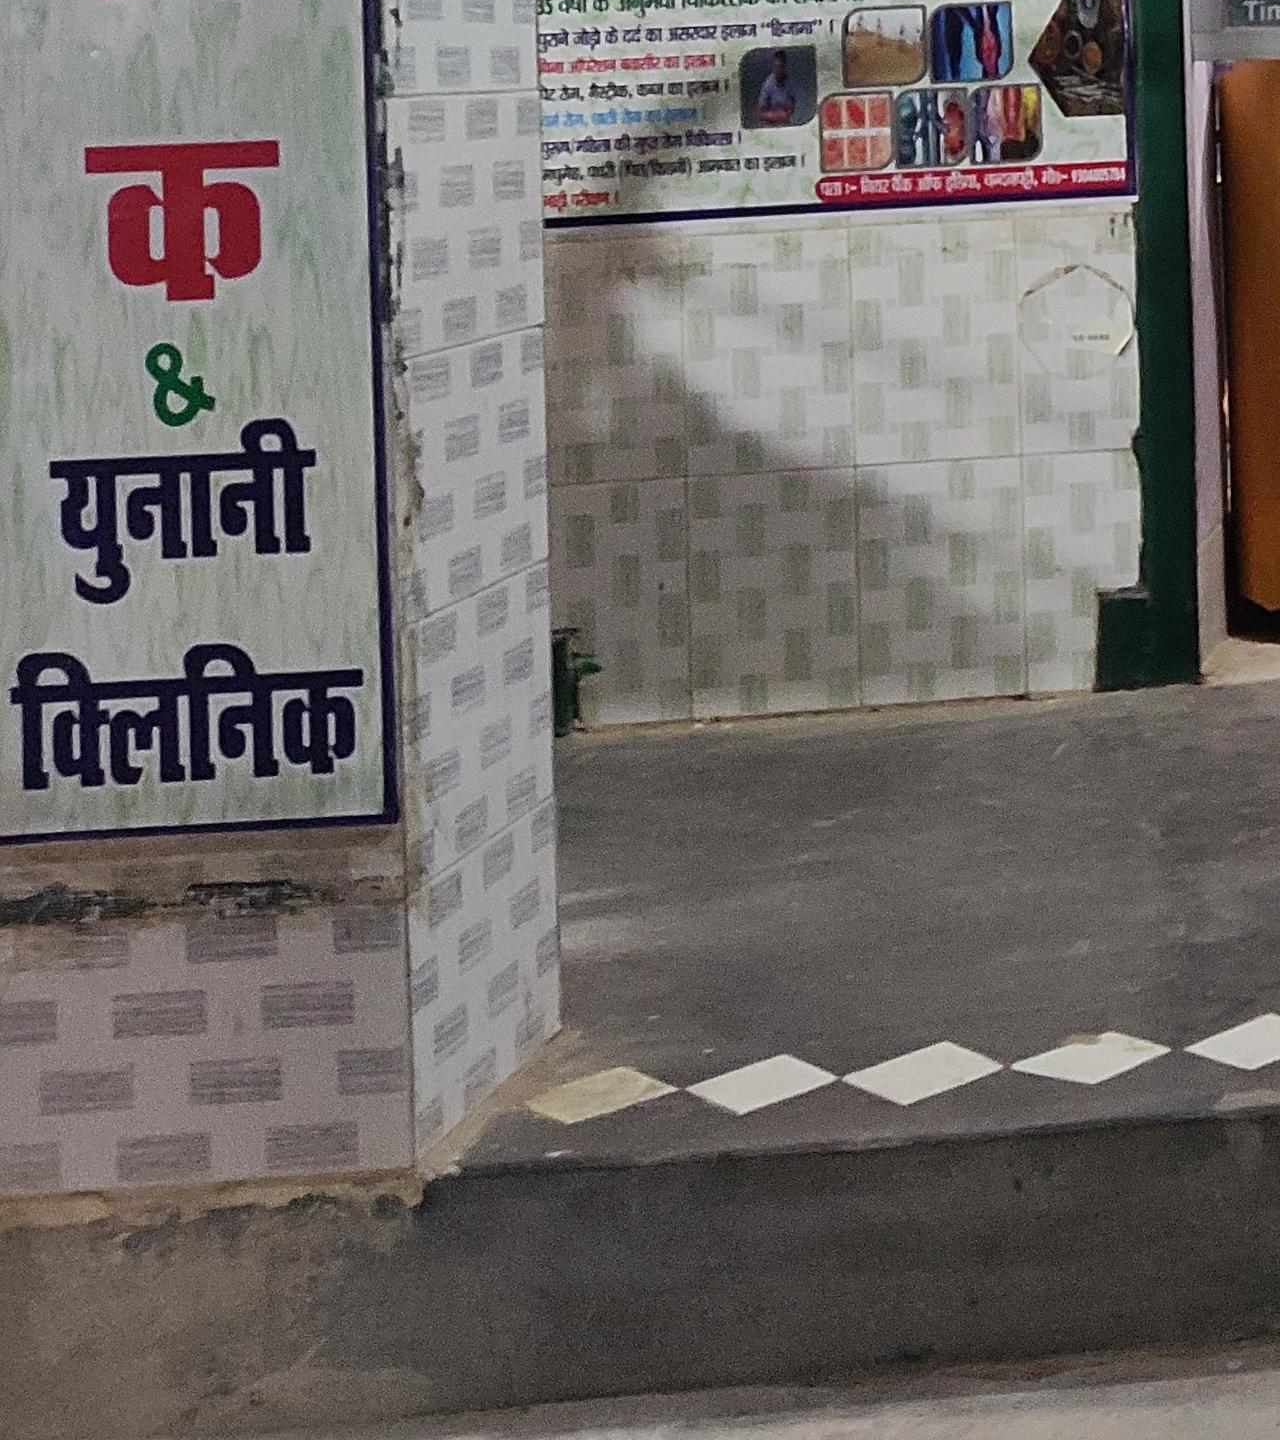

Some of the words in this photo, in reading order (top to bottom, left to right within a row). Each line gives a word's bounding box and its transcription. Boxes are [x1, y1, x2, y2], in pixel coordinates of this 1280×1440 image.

[145, 342, 216, 427] &
[49, 417, 316, 605] युनानी
[9, 642, 363, 791] क्लिनिक
